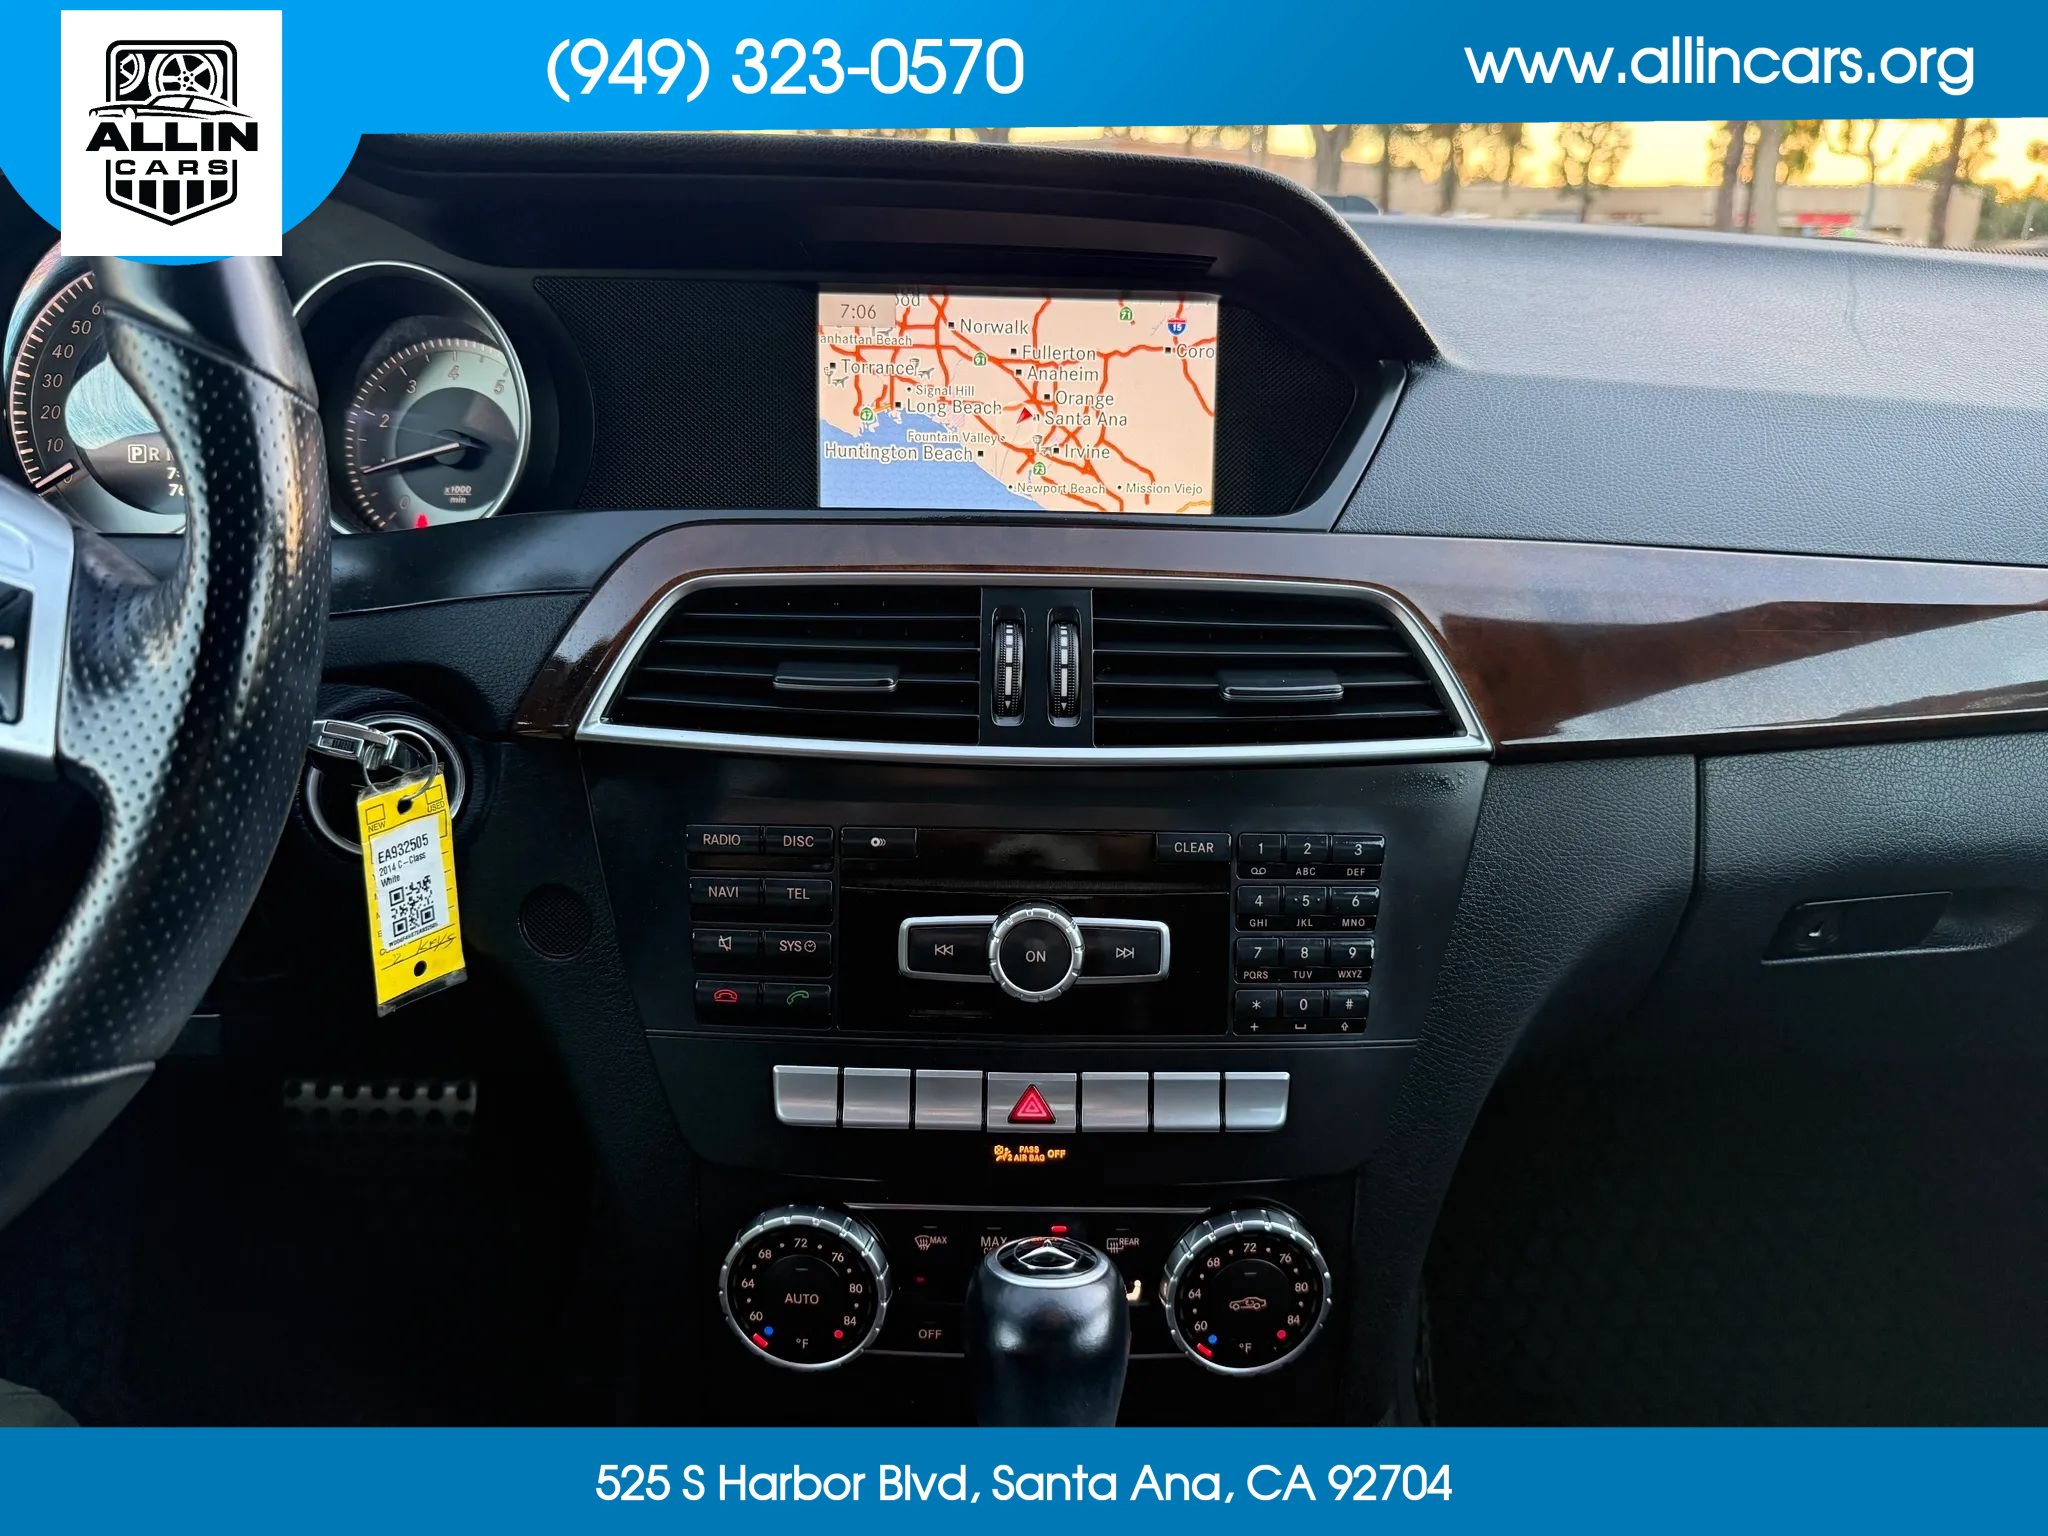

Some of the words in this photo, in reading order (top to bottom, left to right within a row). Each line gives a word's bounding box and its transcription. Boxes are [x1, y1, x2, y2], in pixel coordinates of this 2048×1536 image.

[92, 301, 106, 316] 6
[841, 304, 876, 319] 7:06
[1121, 311, 1131, 320] 71
[71, 320, 91, 335] 50
[960, 318, 1028, 334] Norwalk
[1173, 324, 1182, 332] 15
[877, 335, 912, 345] Beach
[52, 345, 74, 359] 40
[1023, 345, 1096, 360] Fullerton
[1177, 344, 1215, 358] Coro
[975, 356, 986, 365] 91
[448, 365, 460, 380] 4
[841, 359, 915, 375] Torrance
[1027, 367, 1099, 381] Anaheim
[42, 374, 63, 388] 30
[406, 380, 417, 394] 3
[494, 380, 506, 394] 5
[915, 385, 951, 397] Signal
[956, 386, 974, 396] Hill
[1056, 391, 1114, 409] Orange
[40, 405, 61, 419] 20
[907, 399, 947, 417] Long
[953, 399, 1002, 415] Beach
[379, 414, 390, 428] 2
[862, 411, 872, 420] 47
[1045, 411, 1091, 425] Santa
[1097, 412, 1127, 426] Ana
[907, 431, 959, 442] Fountain
[962, 432, 998, 444] Valley
[47, 439, 64, 452] 10
[1065, 444, 1110, 459] Irvine
[149, 447, 160, 461] R
[825, 443, 917, 461] Huntington
[923, 445, 973, 460] Beach
[1034, 464, 1045, 474] 73
[1017, 482, 1066, 495] Newport
[1070, 483, 1105, 494] Beach
[1126, 483, 1171, 494] Mission
[1174, 484, 1203, 496] Viejo
[427, 801, 445, 813] USED
[368, 821, 386, 833] NEW
[703, 833, 741, 846] RADIO
[783, 835, 815, 848] DISC
[378, 833, 429, 864] EA932505
[1174, 842, 1214, 854] CLEAR
[1258, 843, 1264, 854] 1
[1304, 843, 1312, 855] 2
[1355, 843, 1363, 855] 3
[379, 863, 396, 876] 2014
[1295, 867, 1316, 876] ABC
[1346, 868, 1366, 876] DEF
[381, 874, 400, 888] White
[708, 886, 739, 898] NAVI
[787, 887, 810, 900] TEL
[1255, 895, 1263, 907] 4
[1302, 895, 1310, 907] 5
[1352, 895, 1360, 907] 6
[1249, 919, 1268, 928] GHI
[1296, 918, 1313, 927] JKL
[1342, 918, 1366, 927] MNO
[779, 940, 802, 952] SYS
[1025, 950, 1046, 963] ON
[1254, 947, 1262, 959] 7
[1300, 947, 1309, 959] 8
[1349, 947, 1357, 959] 9
[1243, 971, 1269, 980] PQRS
[1293, 970, 1313, 979] TUV
[1337, 970, 1363, 978] WXYZ
[1300, 998, 1308, 1011] 0
[1019, 1145, 1040, 1154] PASS
[1047, 1149, 1066, 1158] OFF
[1014, 1154, 1027, 1162] AIR
[1029, 1154, 1045, 1162] BAG
[794, 1238, 808, 1248] 72
[930, 1236, 947, 1244] MAX
[1119, 1237, 1140, 1246] REAR
[1243, 1243, 1257, 1253] 72
[758, 1249, 772, 1260] 68
[831, 1252, 845, 1263] 76
[1279, 1253, 1292, 1264] 76
[1206, 1257, 1220, 1267] 68
[741, 1278, 755, 1289] 64
[849, 1283, 863, 1293] 80
[1294, 1282, 1308, 1292] 80
[784, 1293, 819, 1305] AUTO
[1188, 1288, 1201, 1299] 64
[749, 1311, 763, 1321] 60
[843, 1316, 857, 1326] 84
[1287, 1315, 1300, 1325] 84
[1194, 1320, 1208, 1331] 60
[918, 1328, 943, 1340] OFF
